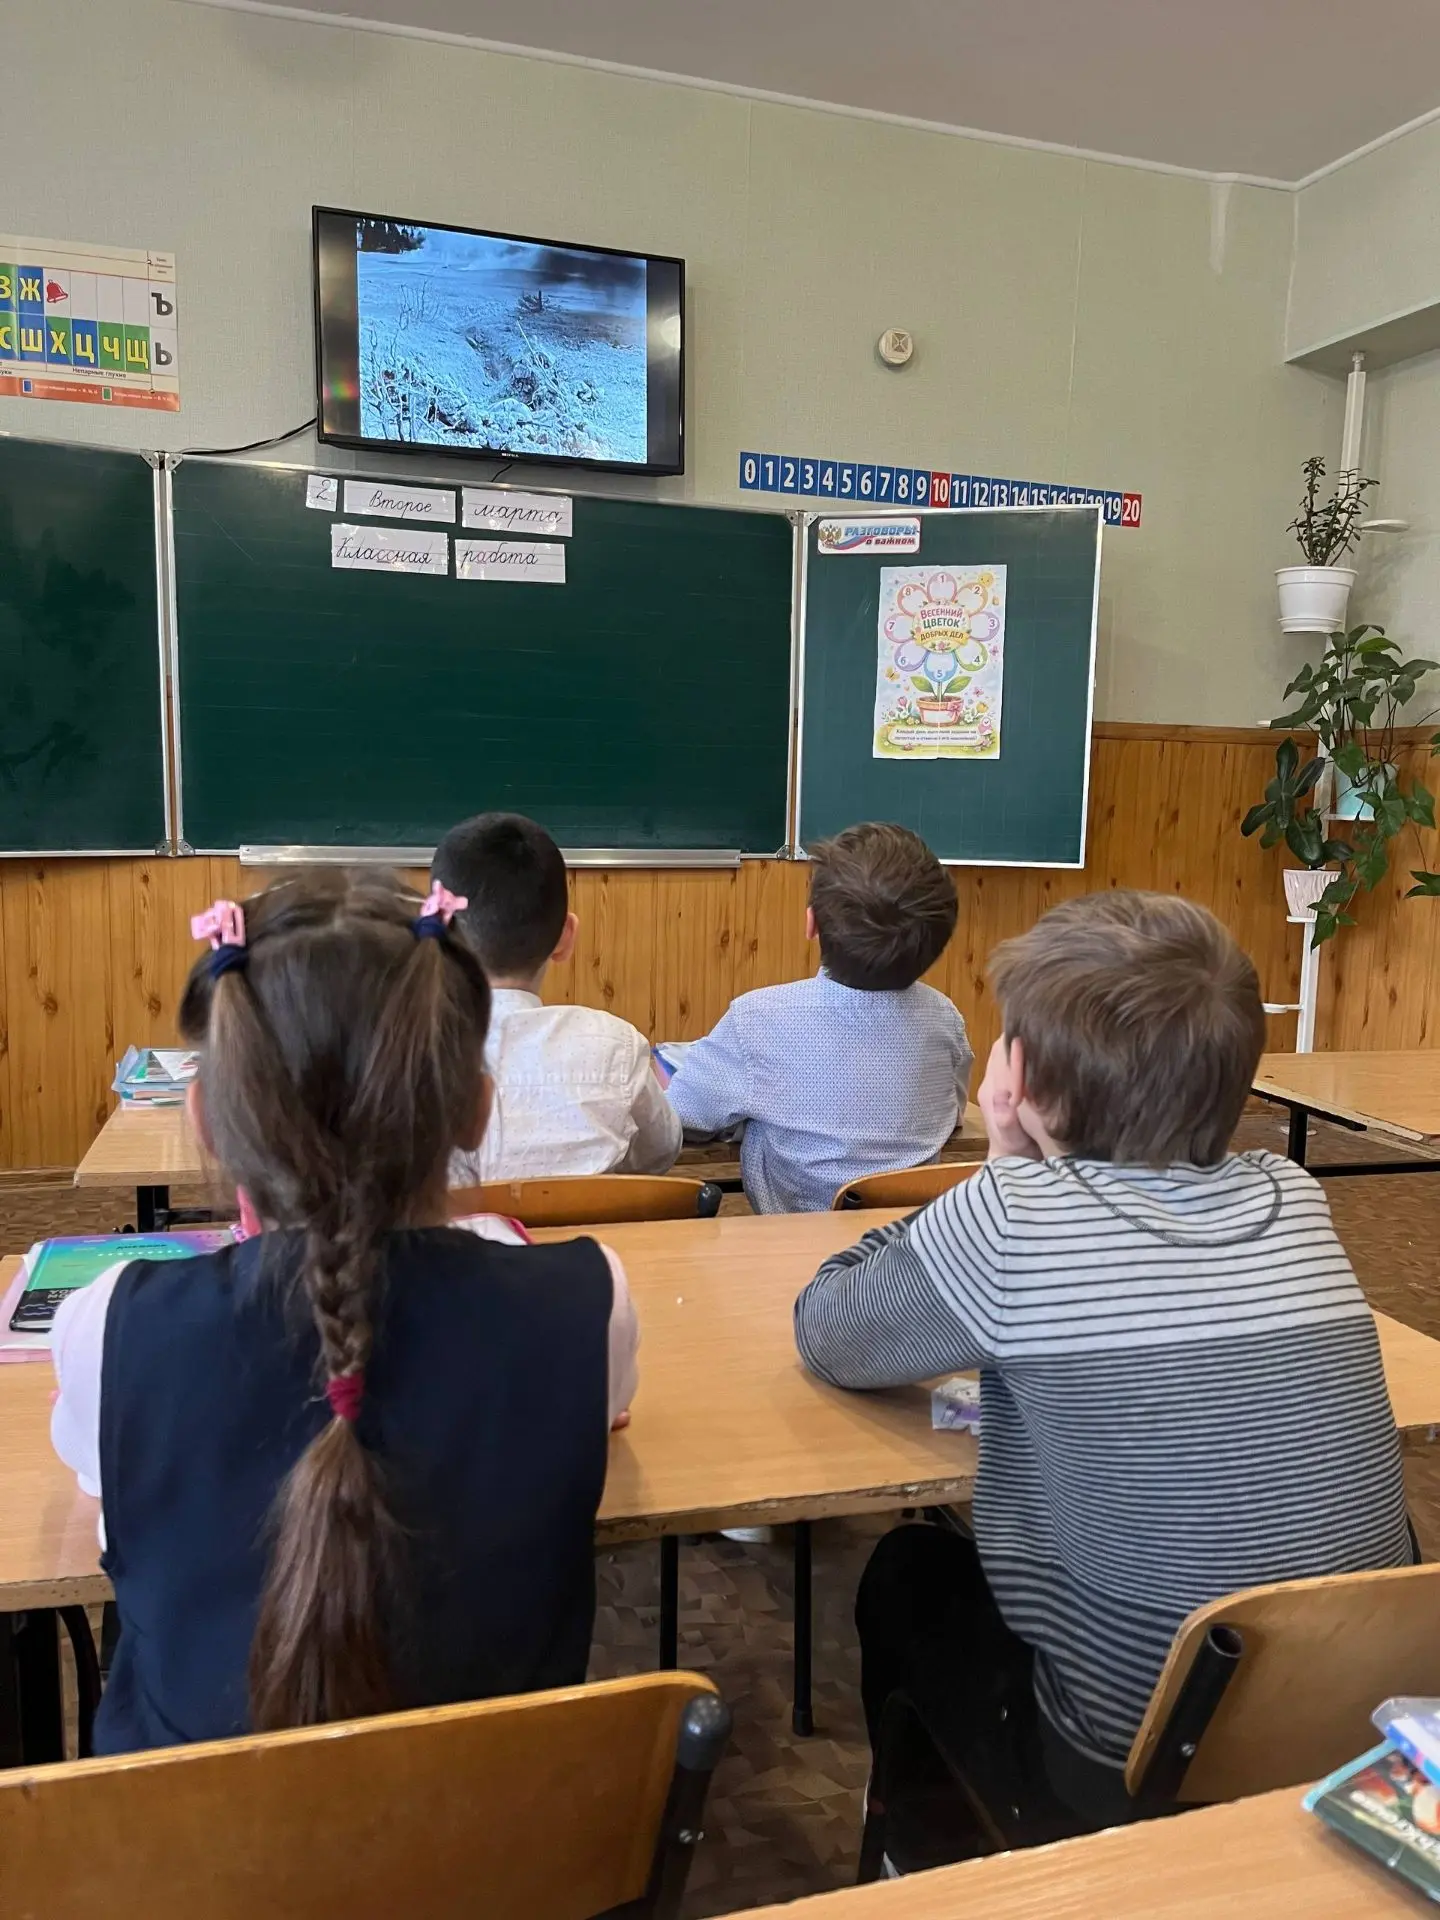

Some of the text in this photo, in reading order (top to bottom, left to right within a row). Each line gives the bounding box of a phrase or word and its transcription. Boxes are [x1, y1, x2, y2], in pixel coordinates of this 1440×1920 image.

[19, 277, 42, 302] Ж
[151, 292, 173, 316] Ъ
[20, 328, 43, 353] Ш
[50, 330, 66, 355] Х
[75, 333, 94, 364] Ц
[103, 336, 120, 361] Ч
[127, 338, 149, 370] Щ
[155, 342, 173, 366] Ь
[316, 479, 333, 500] 2
[369, 490, 433, 519] Второе
[744, 458, 756, 484] 0
[765, 461, 774, 486] 1
[783, 462, 795, 488] 2
[803, 464, 814, 490] 3
[822, 467, 834, 492] 4
[841, 469, 852, 493] 5
[860, 471, 872, 495] 6
[879, 472, 891, 497] 7
[897, 474, 909, 499] 8
[916, 476, 927, 500] 9
[932, 478, 949, 503] 10
[952, 480, 968, 504] 11
[972, 481, 988, 506] 12
[992, 484, 1008, 507] 13
[1012, 486, 1028, 506] 14
[1031, 488, 1048, 505] 15
[1106, 496, 1122, 520] 19
[1122, 498, 1140, 522] 20
[844, 525, 917, 536] РАЗГОВОРЫ
[336, 537, 539, 570] Классная работа
[920, 608, 963, 619] ВЕСЕННИЙ
[923, 618, 960, 629] ЦВЕТОК
[920, 630, 964, 641] ДОБРЫХ ДЕЛ
